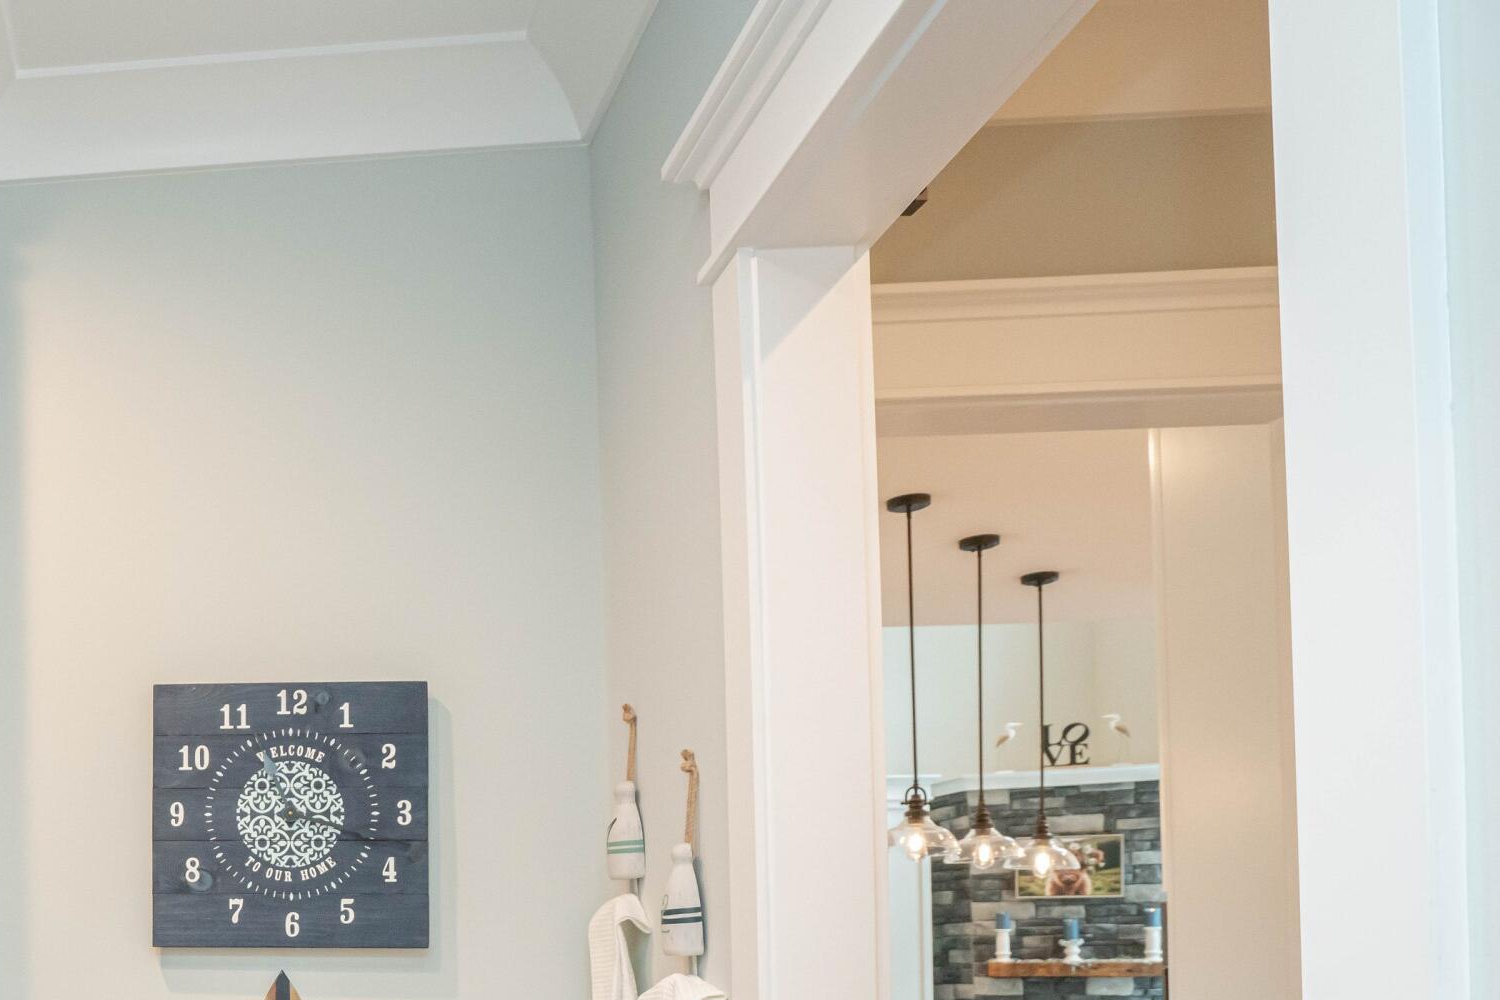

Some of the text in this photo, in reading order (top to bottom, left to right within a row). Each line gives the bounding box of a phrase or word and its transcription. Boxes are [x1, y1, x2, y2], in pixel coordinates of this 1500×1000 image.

[276, 689, 308, 715] 12
[339, 702, 354, 728] 1
[219, 703, 251, 729] 11
[178, 744, 210, 771] 10
[381, 743, 397, 769] 2
[169, 801, 185, 827] 9
[396, 800, 412, 826] 3
[185, 857, 200, 883] 8
[244, 856, 337, 882] TO OUR HOME
[382, 856, 398, 883] 4
[228, 898, 244, 924] 7
[340, 898, 355, 924] 5
[284, 911, 300, 938] 6
